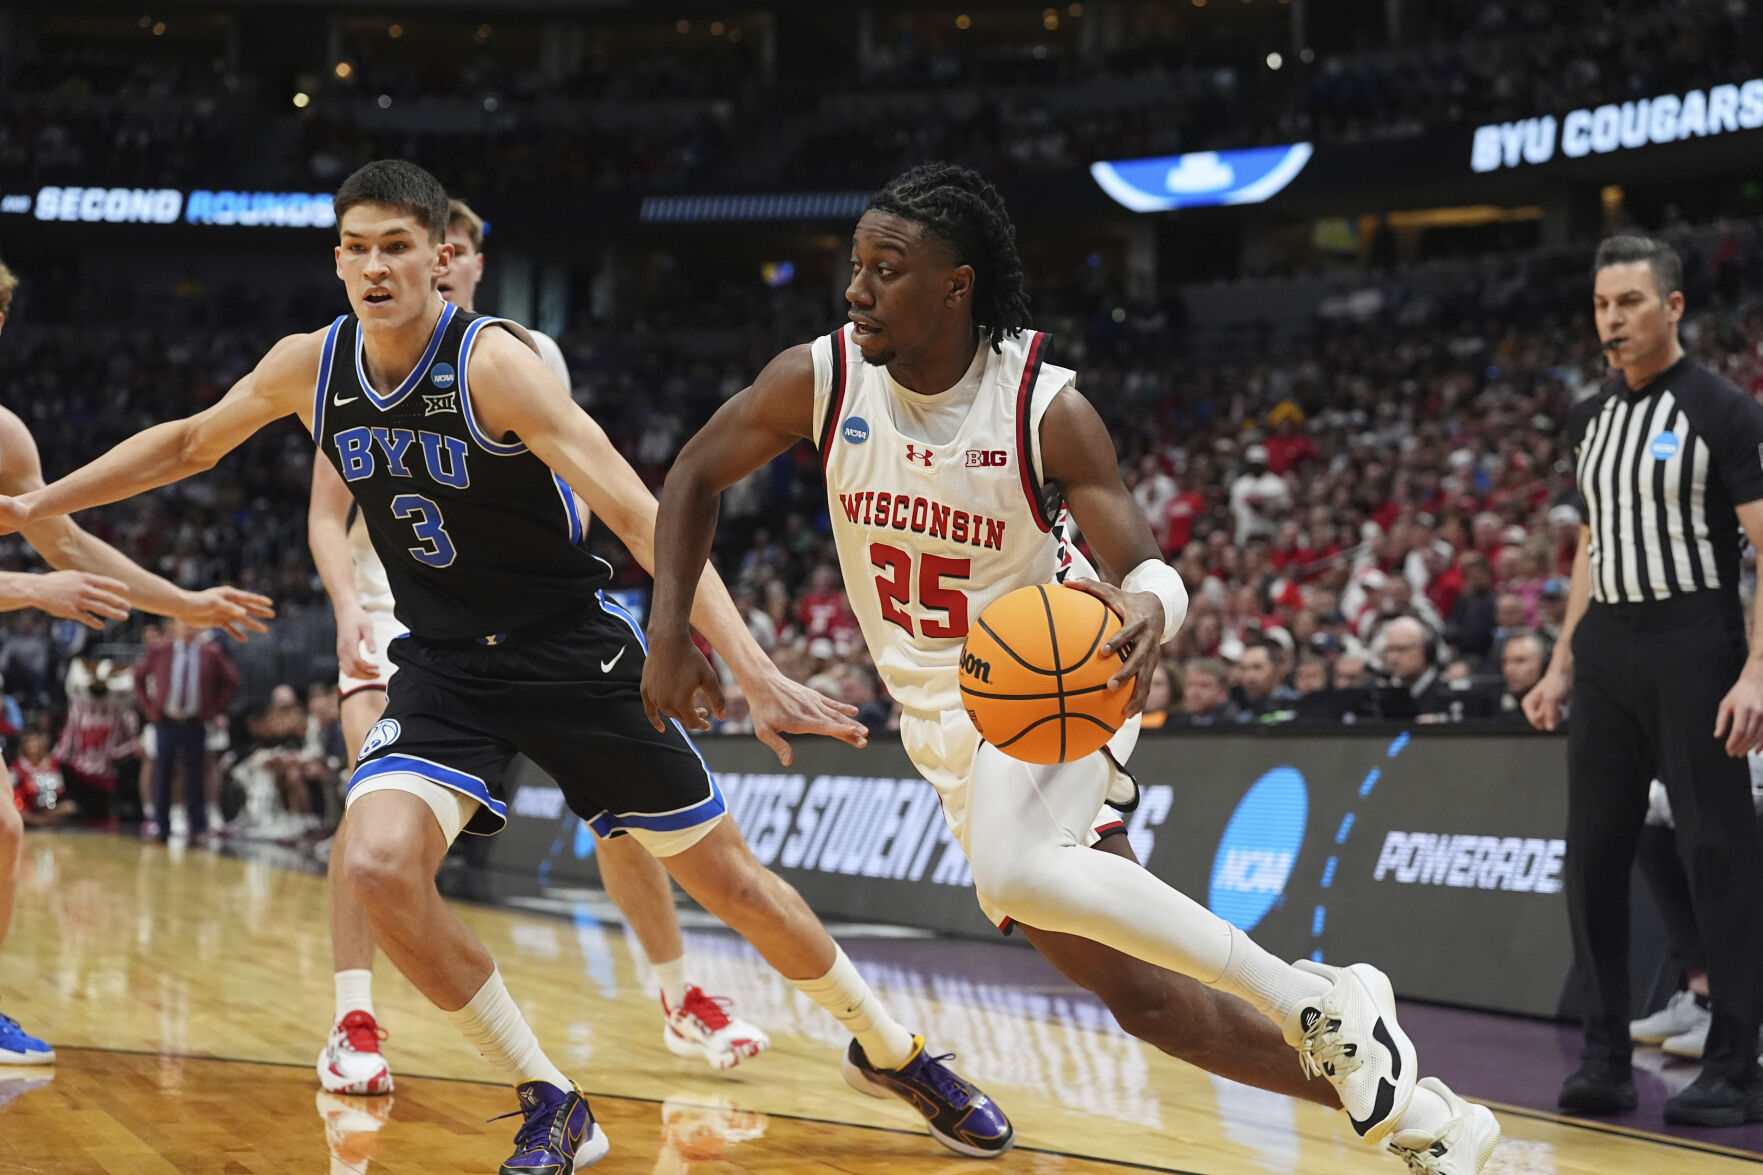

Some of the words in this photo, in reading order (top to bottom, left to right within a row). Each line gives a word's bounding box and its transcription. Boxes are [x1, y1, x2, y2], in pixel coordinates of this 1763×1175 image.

[1471, 115, 1557, 173] BYU
[1561, 79, 1763, 158] COUGARS
[34, 186, 184, 224] SECOND
[433, 374, 455, 382] NCAA
[333, 426, 470, 489] BYU
[844, 427, 867, 440] NCAA
[390, 494, 457, 568] 3
[839, 491, 1006, 551] WISCONSIN
[869, 542, 971, 639] 25
[1374, 831, 1566, 893] POWERADE
